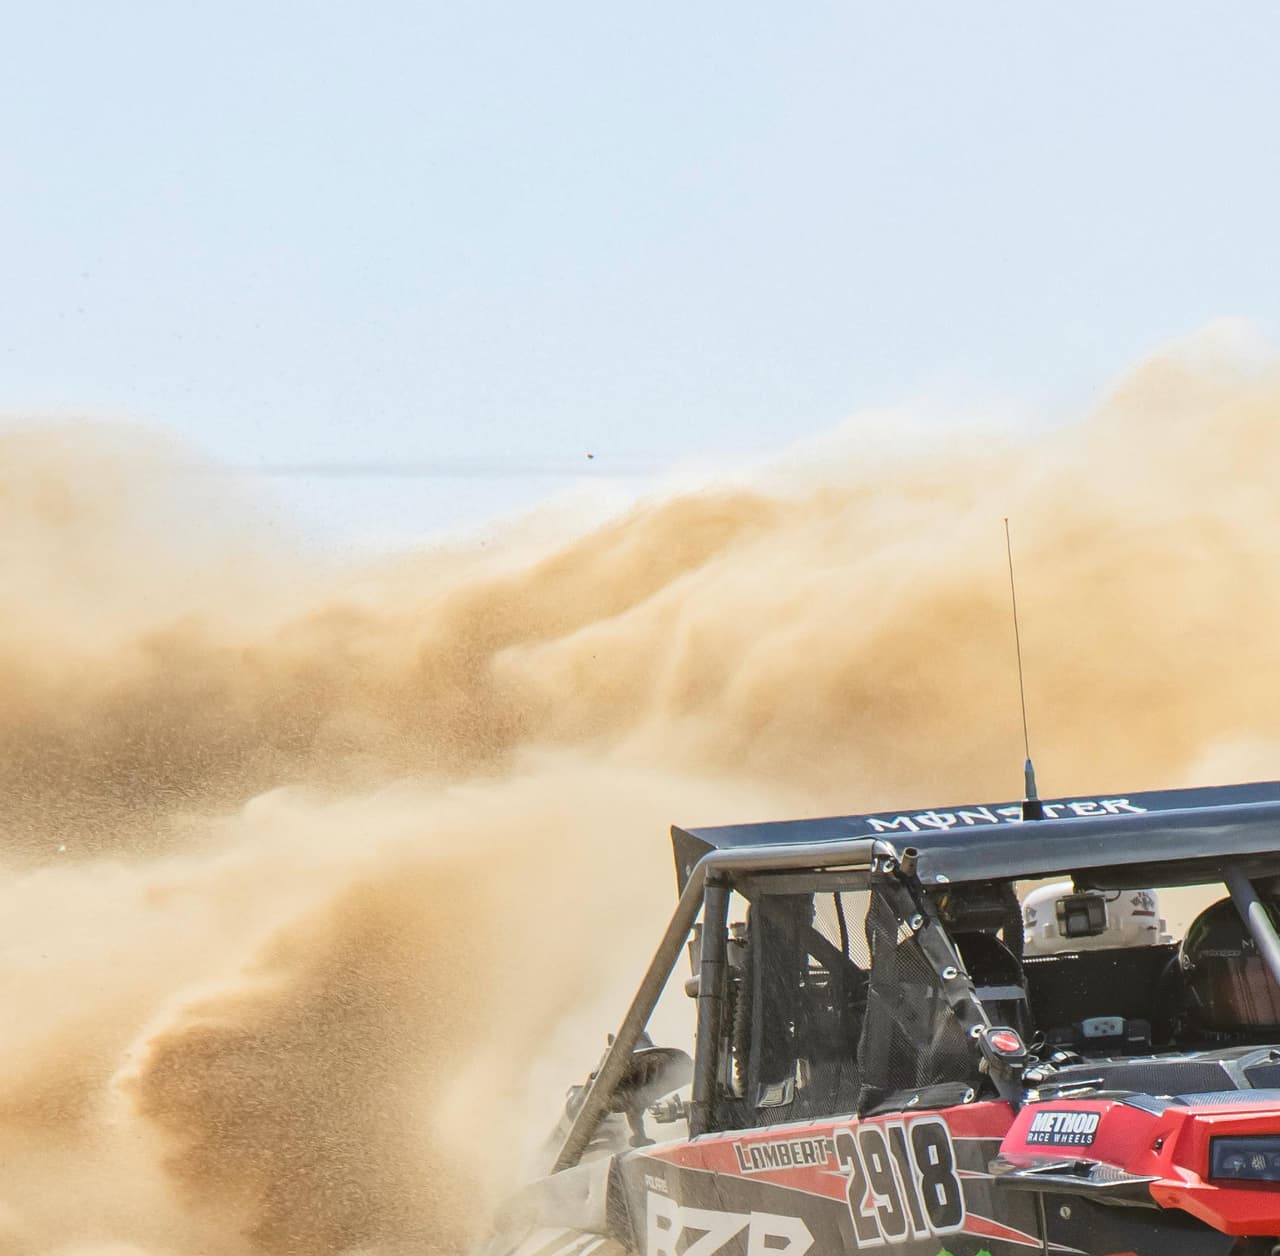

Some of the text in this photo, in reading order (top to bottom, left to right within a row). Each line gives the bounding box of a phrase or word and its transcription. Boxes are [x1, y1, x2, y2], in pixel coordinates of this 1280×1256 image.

[1027, 1132, 1093, 1144] RACE WHEELS
[1030, 1112, 1100, 1134] METHOD
[733, 1136, 829, 1174] LAMBERT
[833, 1116, 966, 1249] 2918
